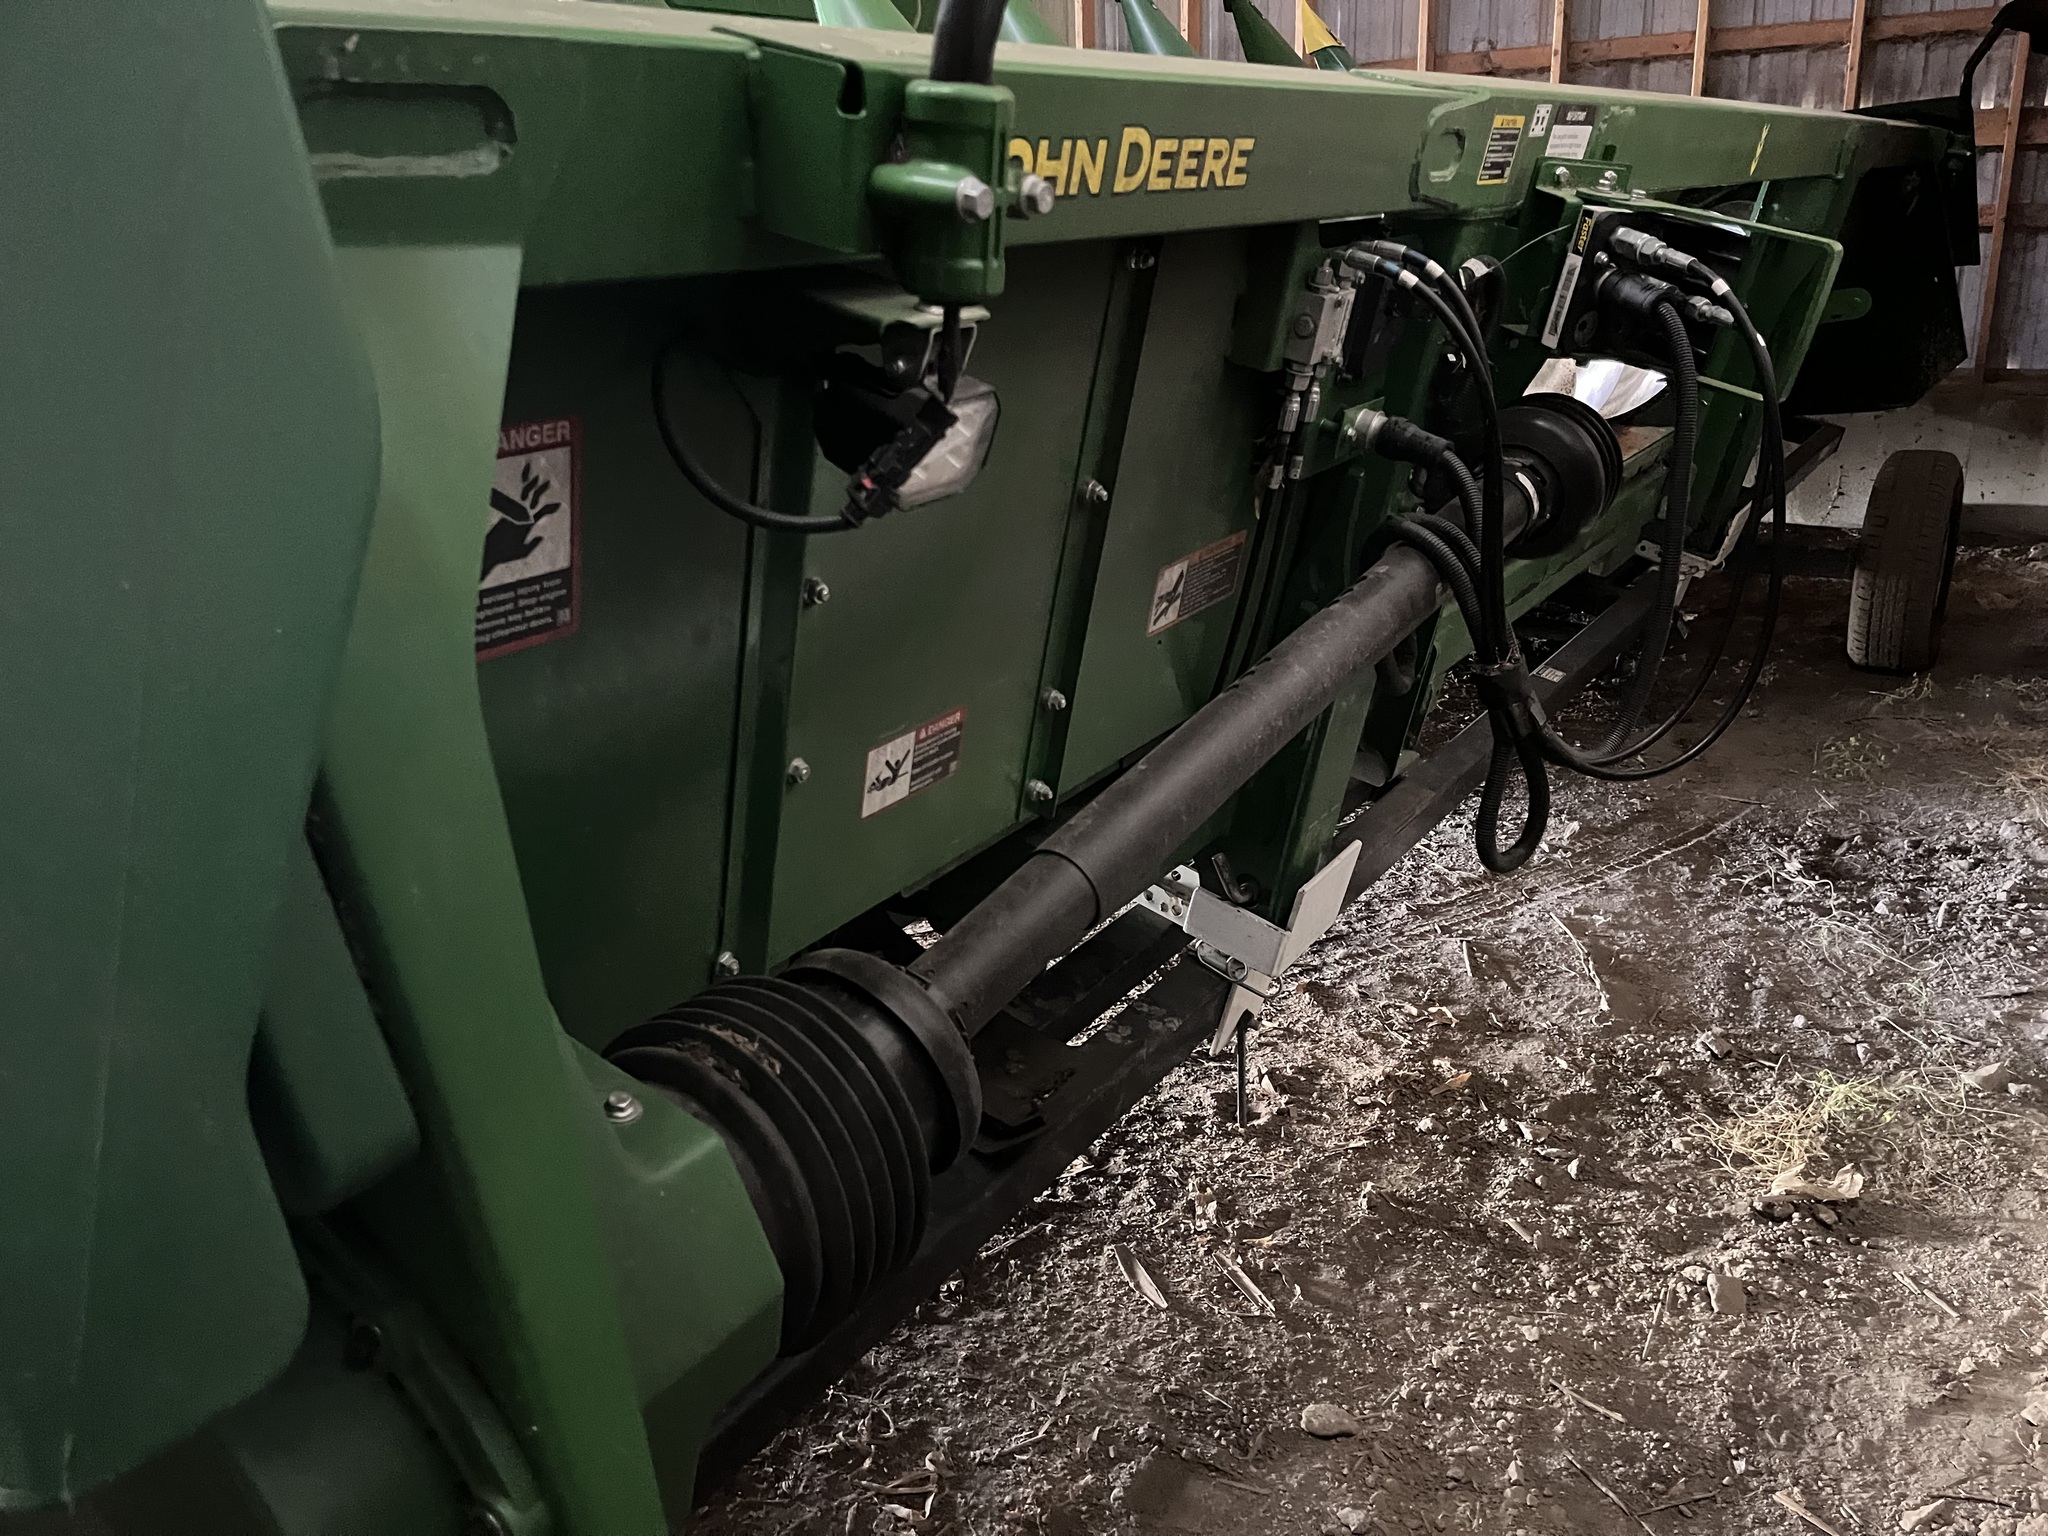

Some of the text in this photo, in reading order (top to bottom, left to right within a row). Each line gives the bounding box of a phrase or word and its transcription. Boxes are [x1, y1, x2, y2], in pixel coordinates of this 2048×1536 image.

[1008, 126, 1255, 197] OHN DEERE
[1577, 216, 1593, 253] Faster
[498, 420, 570, 451] ANGER
